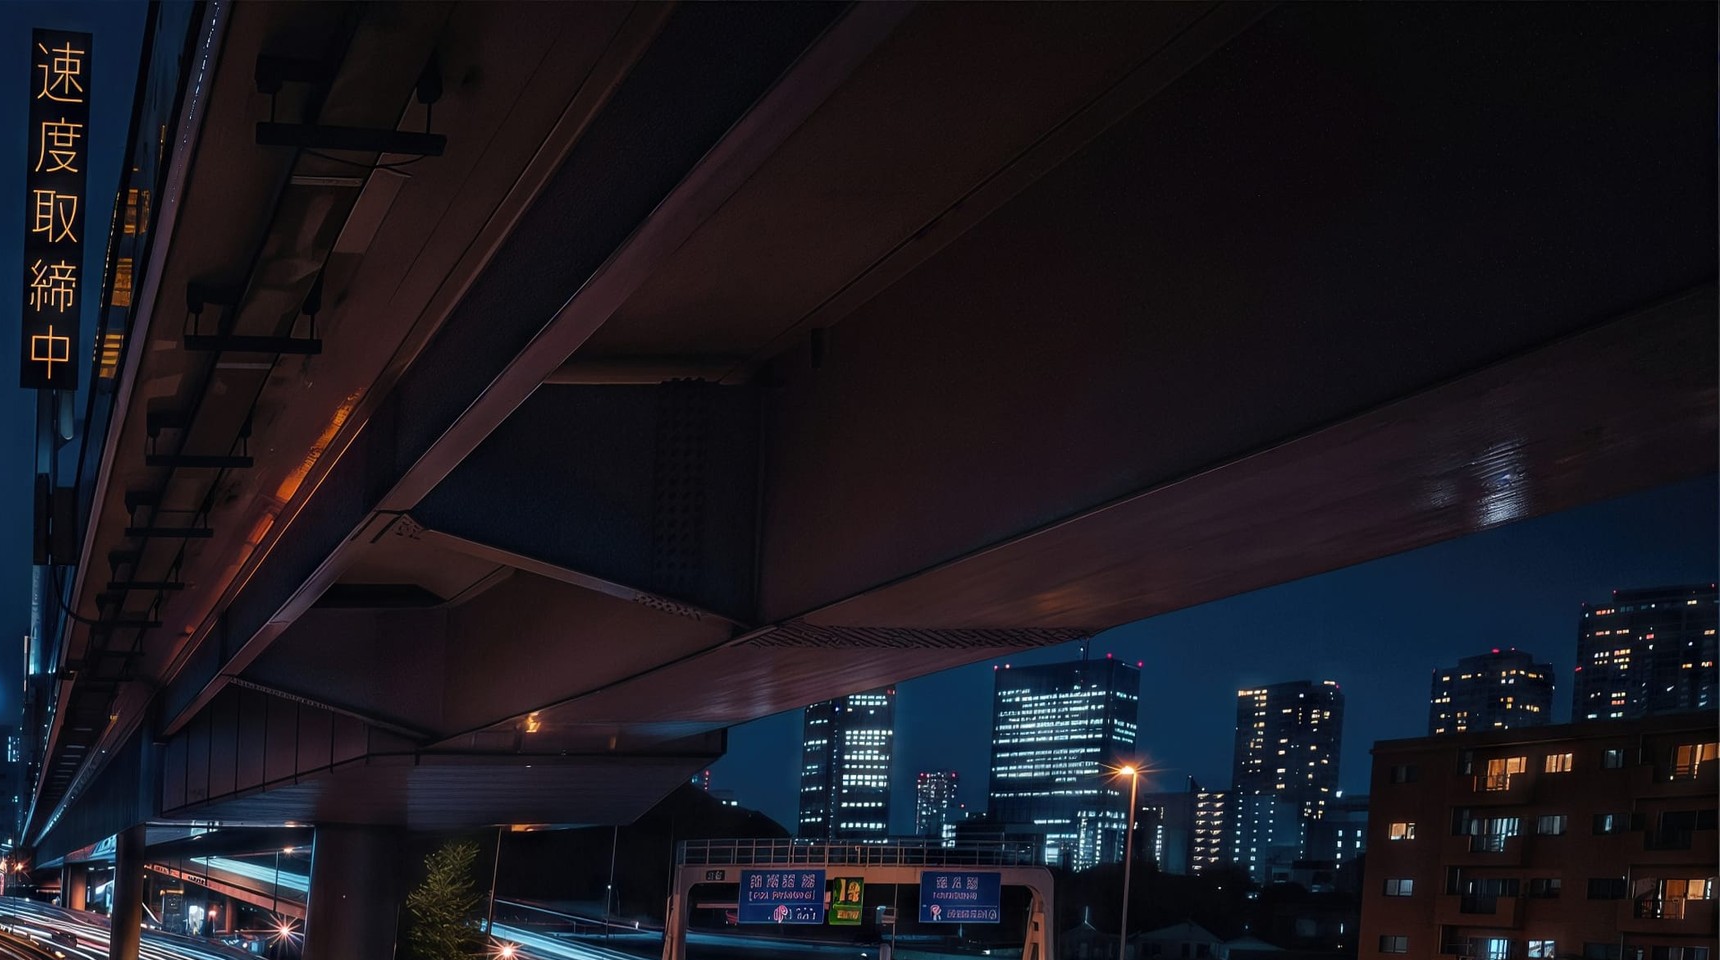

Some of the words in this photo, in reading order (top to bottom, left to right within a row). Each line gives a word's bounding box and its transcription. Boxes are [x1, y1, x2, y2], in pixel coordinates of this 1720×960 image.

[30, 41, 85, 380] 速度取締中
